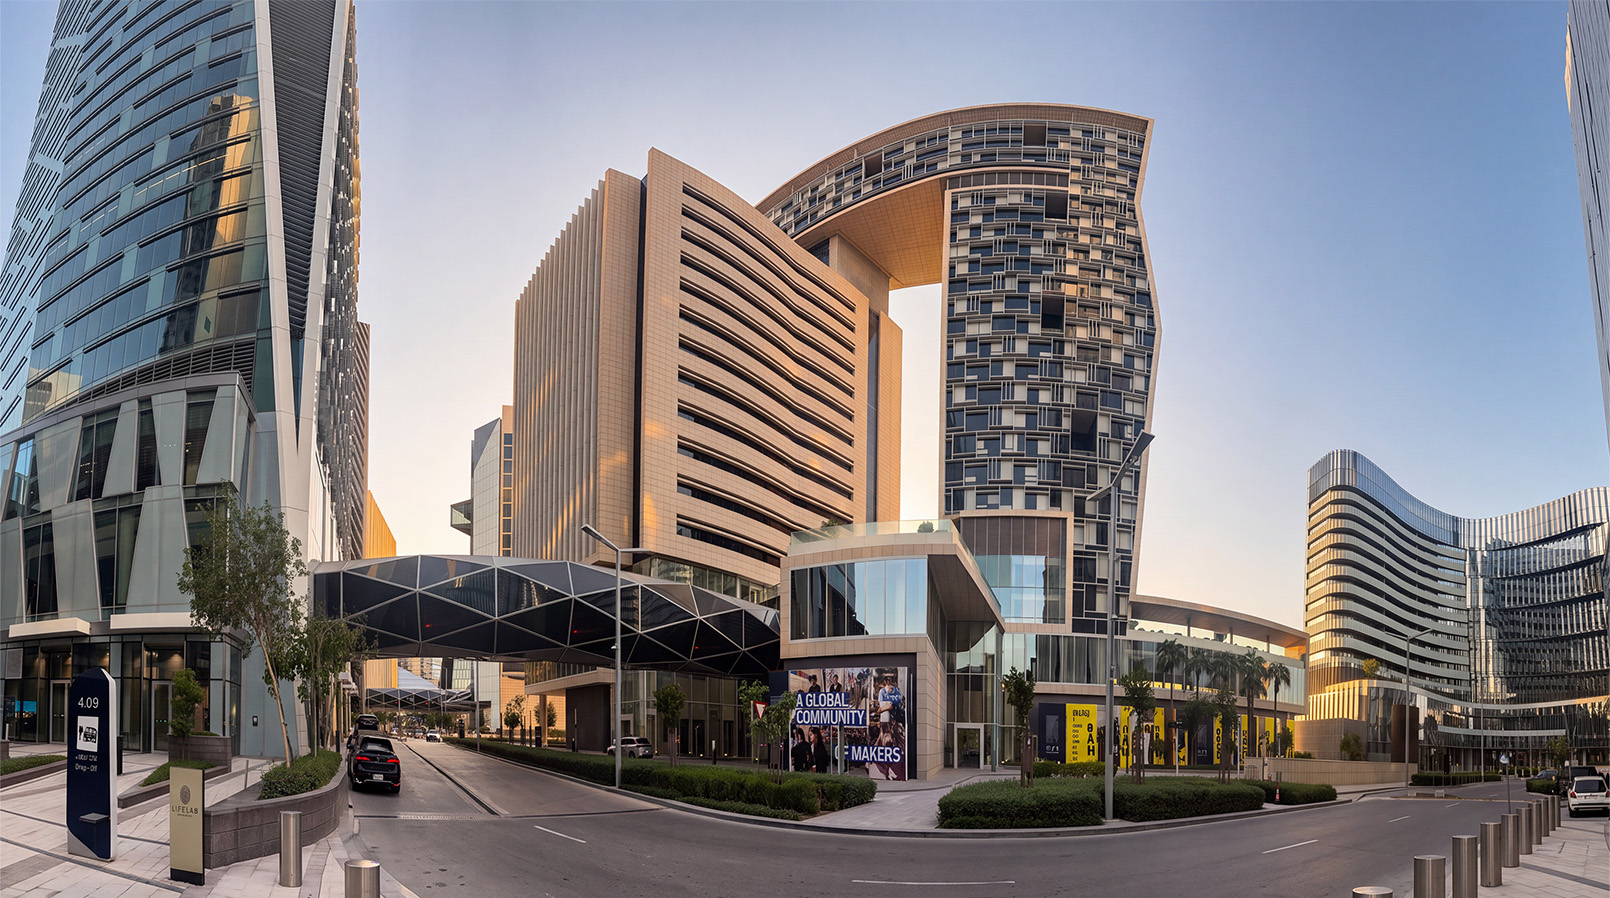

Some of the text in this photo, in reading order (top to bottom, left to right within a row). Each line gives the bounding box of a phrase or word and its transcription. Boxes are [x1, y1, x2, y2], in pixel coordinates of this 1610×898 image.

[77, 696, 99, 709] 4.09
[796, 692, 849, 707] A GLOBAL
[796, 709, 865, 725] COMMUNITY
[851, 745, 901, 763] MAKERS
